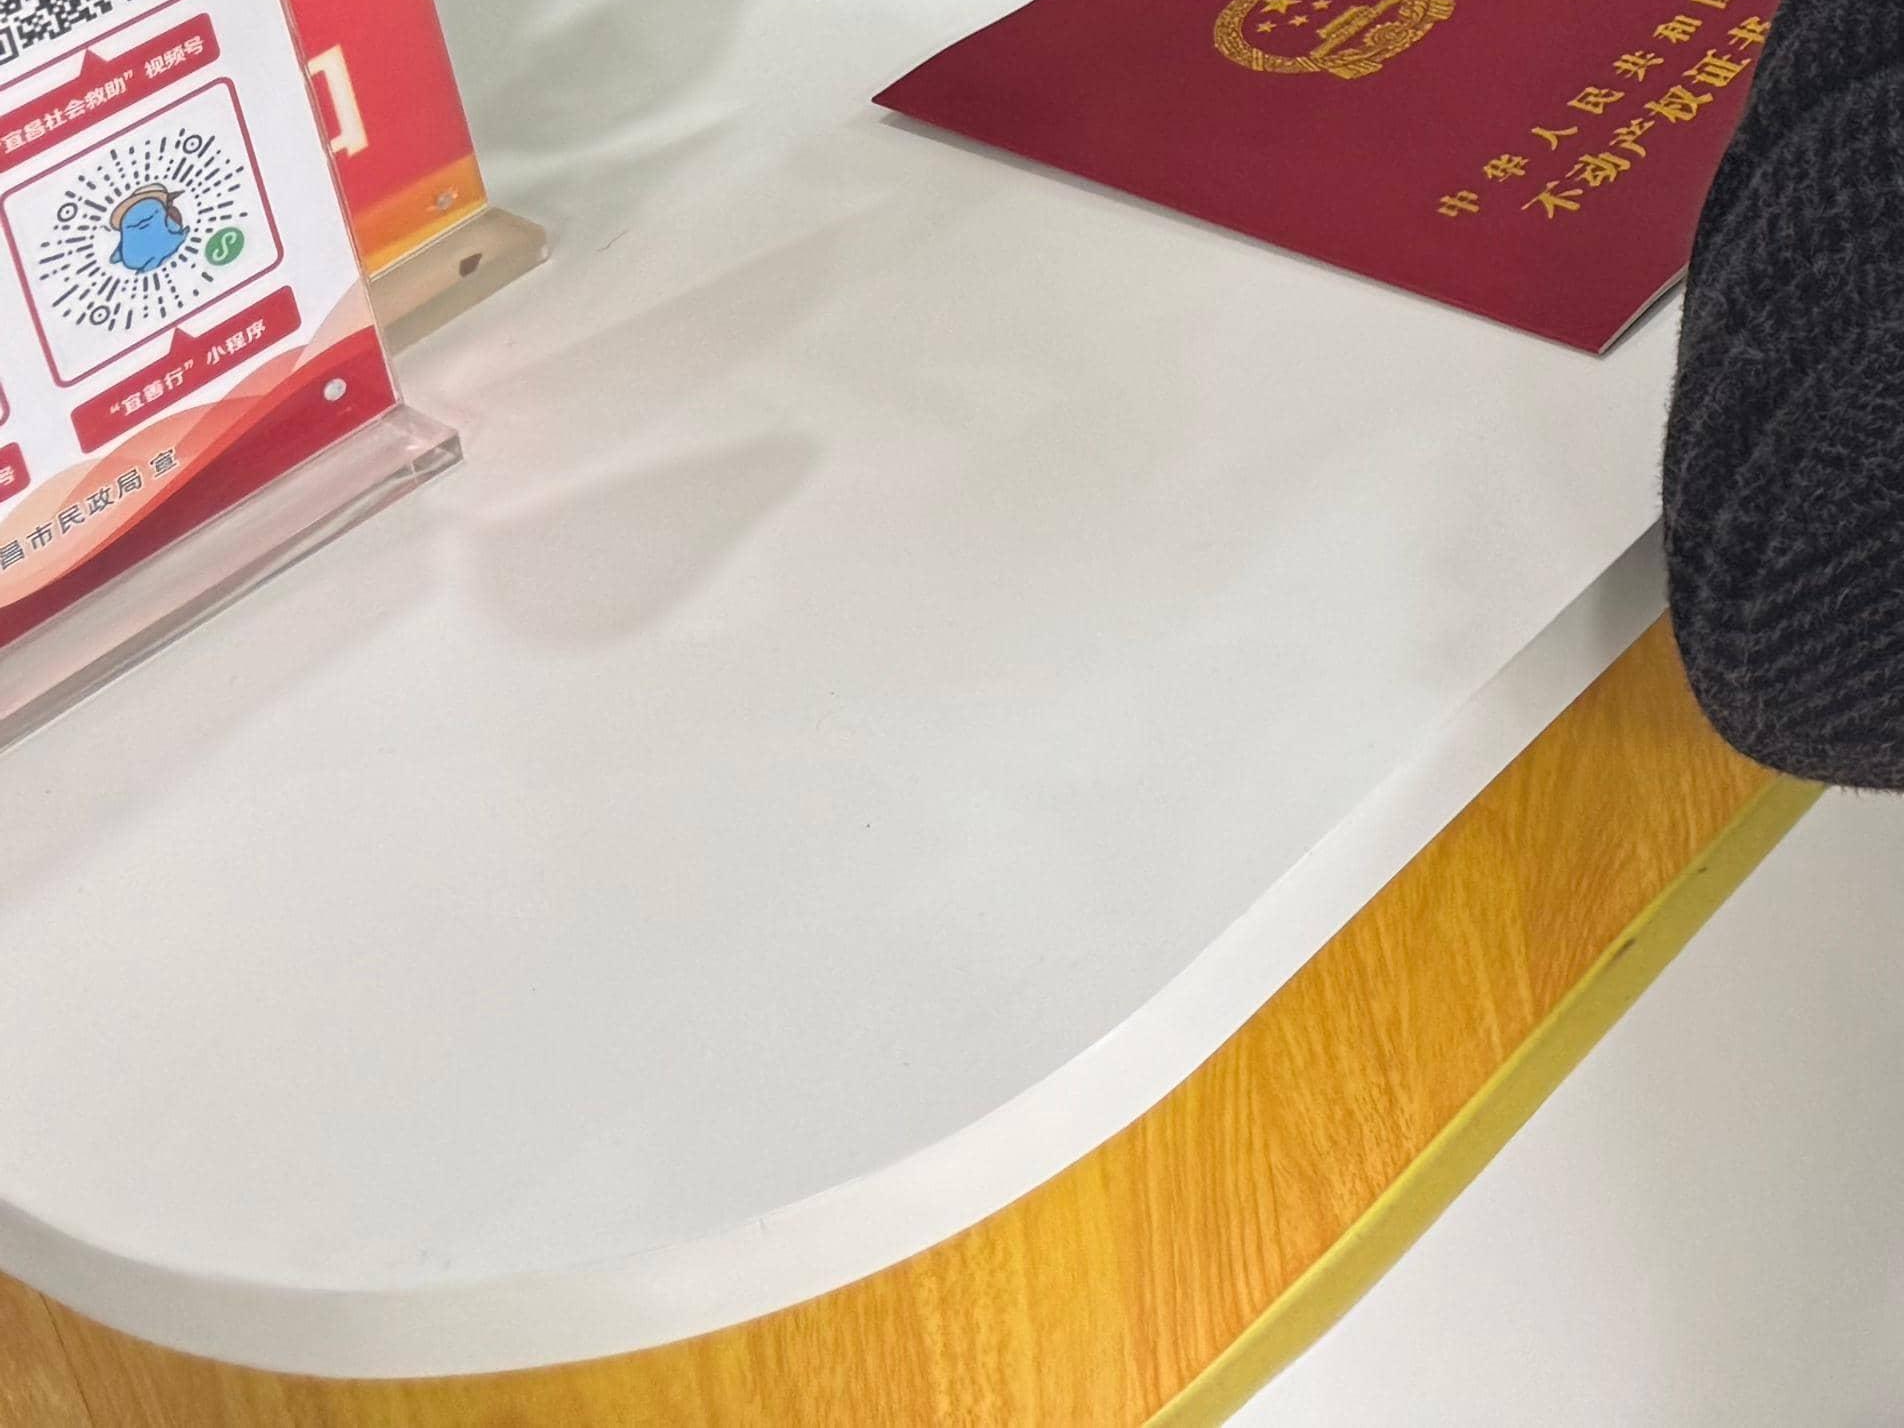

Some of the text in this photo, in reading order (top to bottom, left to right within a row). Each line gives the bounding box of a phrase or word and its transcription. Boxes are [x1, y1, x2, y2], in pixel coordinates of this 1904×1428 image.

[144, 35, 205, 79] 视频号
[1521, 15, 1772, 220] 不动产权证书
[206, 318, 267, 367] 小程序
[0, 447, 179, 571] 昌市民政局 宣
